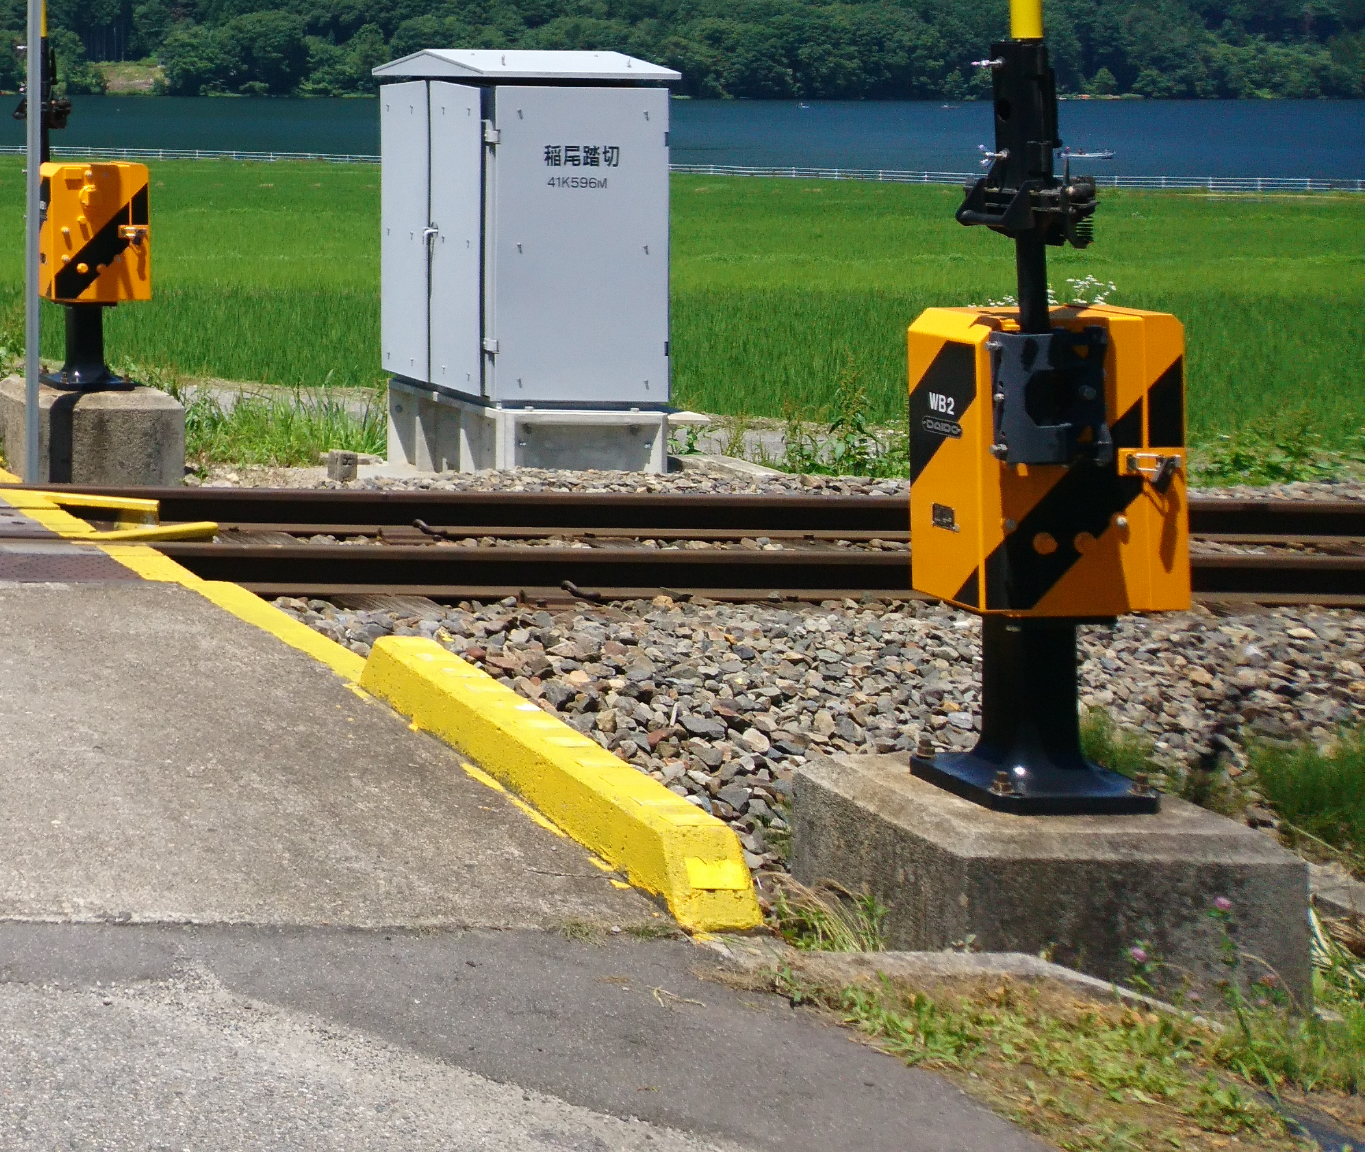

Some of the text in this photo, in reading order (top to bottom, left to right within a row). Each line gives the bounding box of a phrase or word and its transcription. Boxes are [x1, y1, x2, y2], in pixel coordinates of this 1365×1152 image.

[544, 144, 620, 168] 稲尾踏切
[547, 176, 608, 189] 41K596M
[929, 391, 955, 416] WB2
[926, 419, 959, 435] DAIDO
